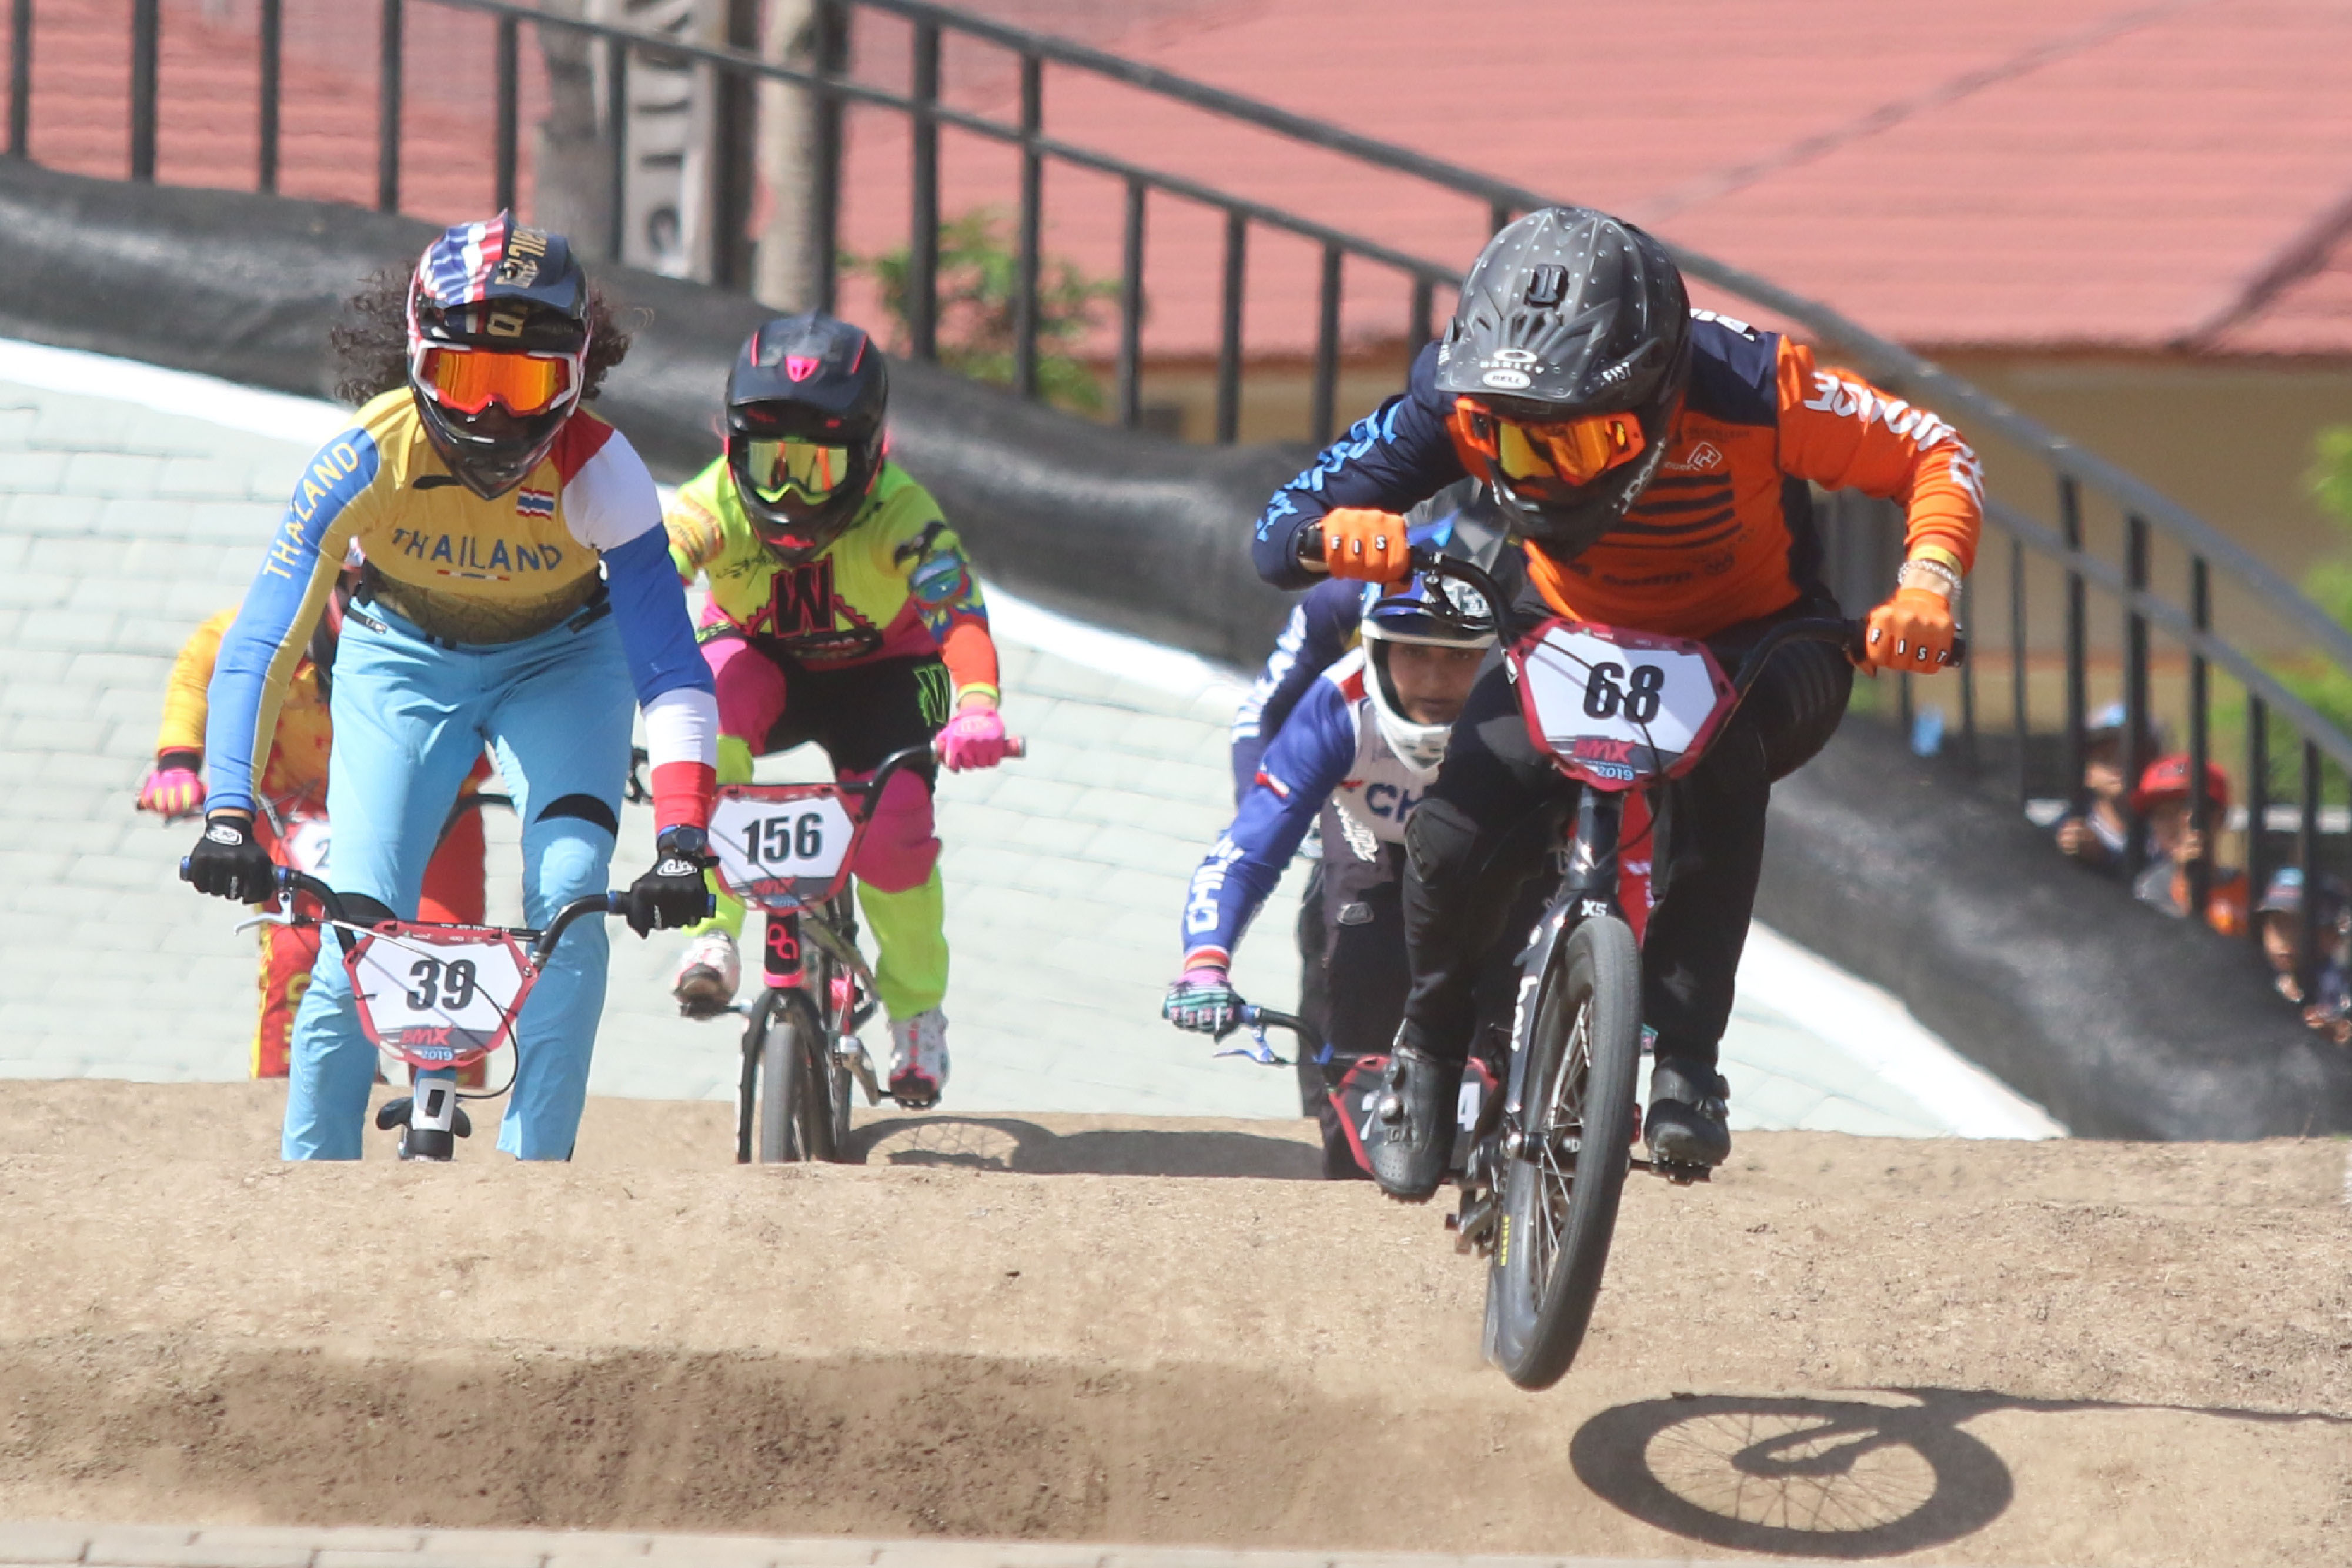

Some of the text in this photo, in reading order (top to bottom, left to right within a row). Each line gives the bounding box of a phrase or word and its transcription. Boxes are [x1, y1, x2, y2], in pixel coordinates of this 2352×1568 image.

[262, 442, 360, 579] THALAND
[392, 529, 563, 573] THAILAND
[1872, 628, 1947, 663] FIST
[1583, 662, 1665, 724] 68
[1597, 765, 1635, 781] 2019
[741, 812, 822, 865] 156
[1581, 899, 1608, 917] X5
[406, 959, 477, 1011] 39
[422, 1048, 453, 1061] 2019
